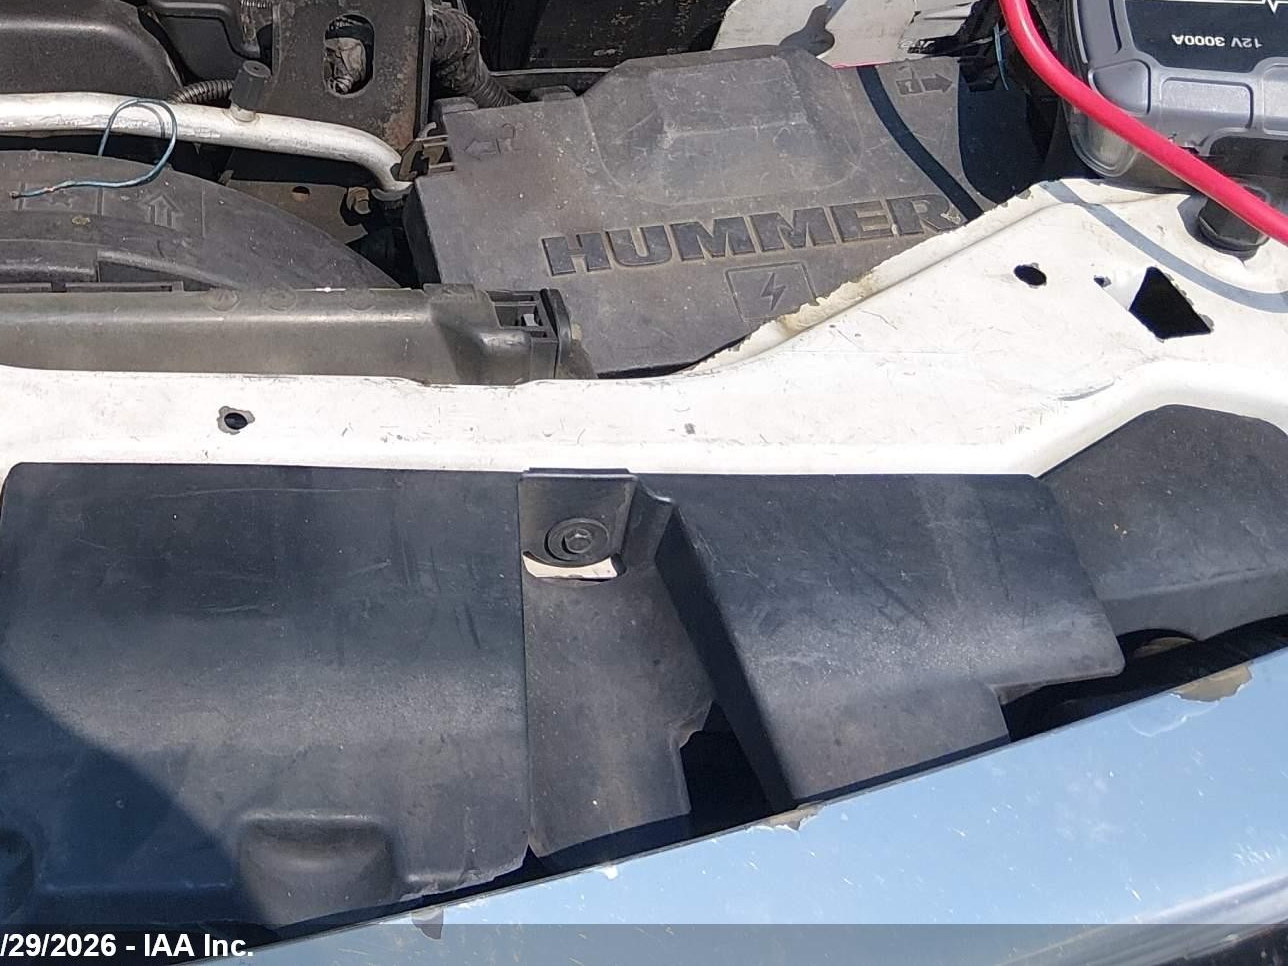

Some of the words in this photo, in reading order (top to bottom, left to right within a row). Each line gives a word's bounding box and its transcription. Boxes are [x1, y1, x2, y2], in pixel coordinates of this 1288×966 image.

[1171, 34, 1225, 47] 3000A
[1231, 37, 1263, 48] 12V
[541, 193, 966, 277] HUMMER
